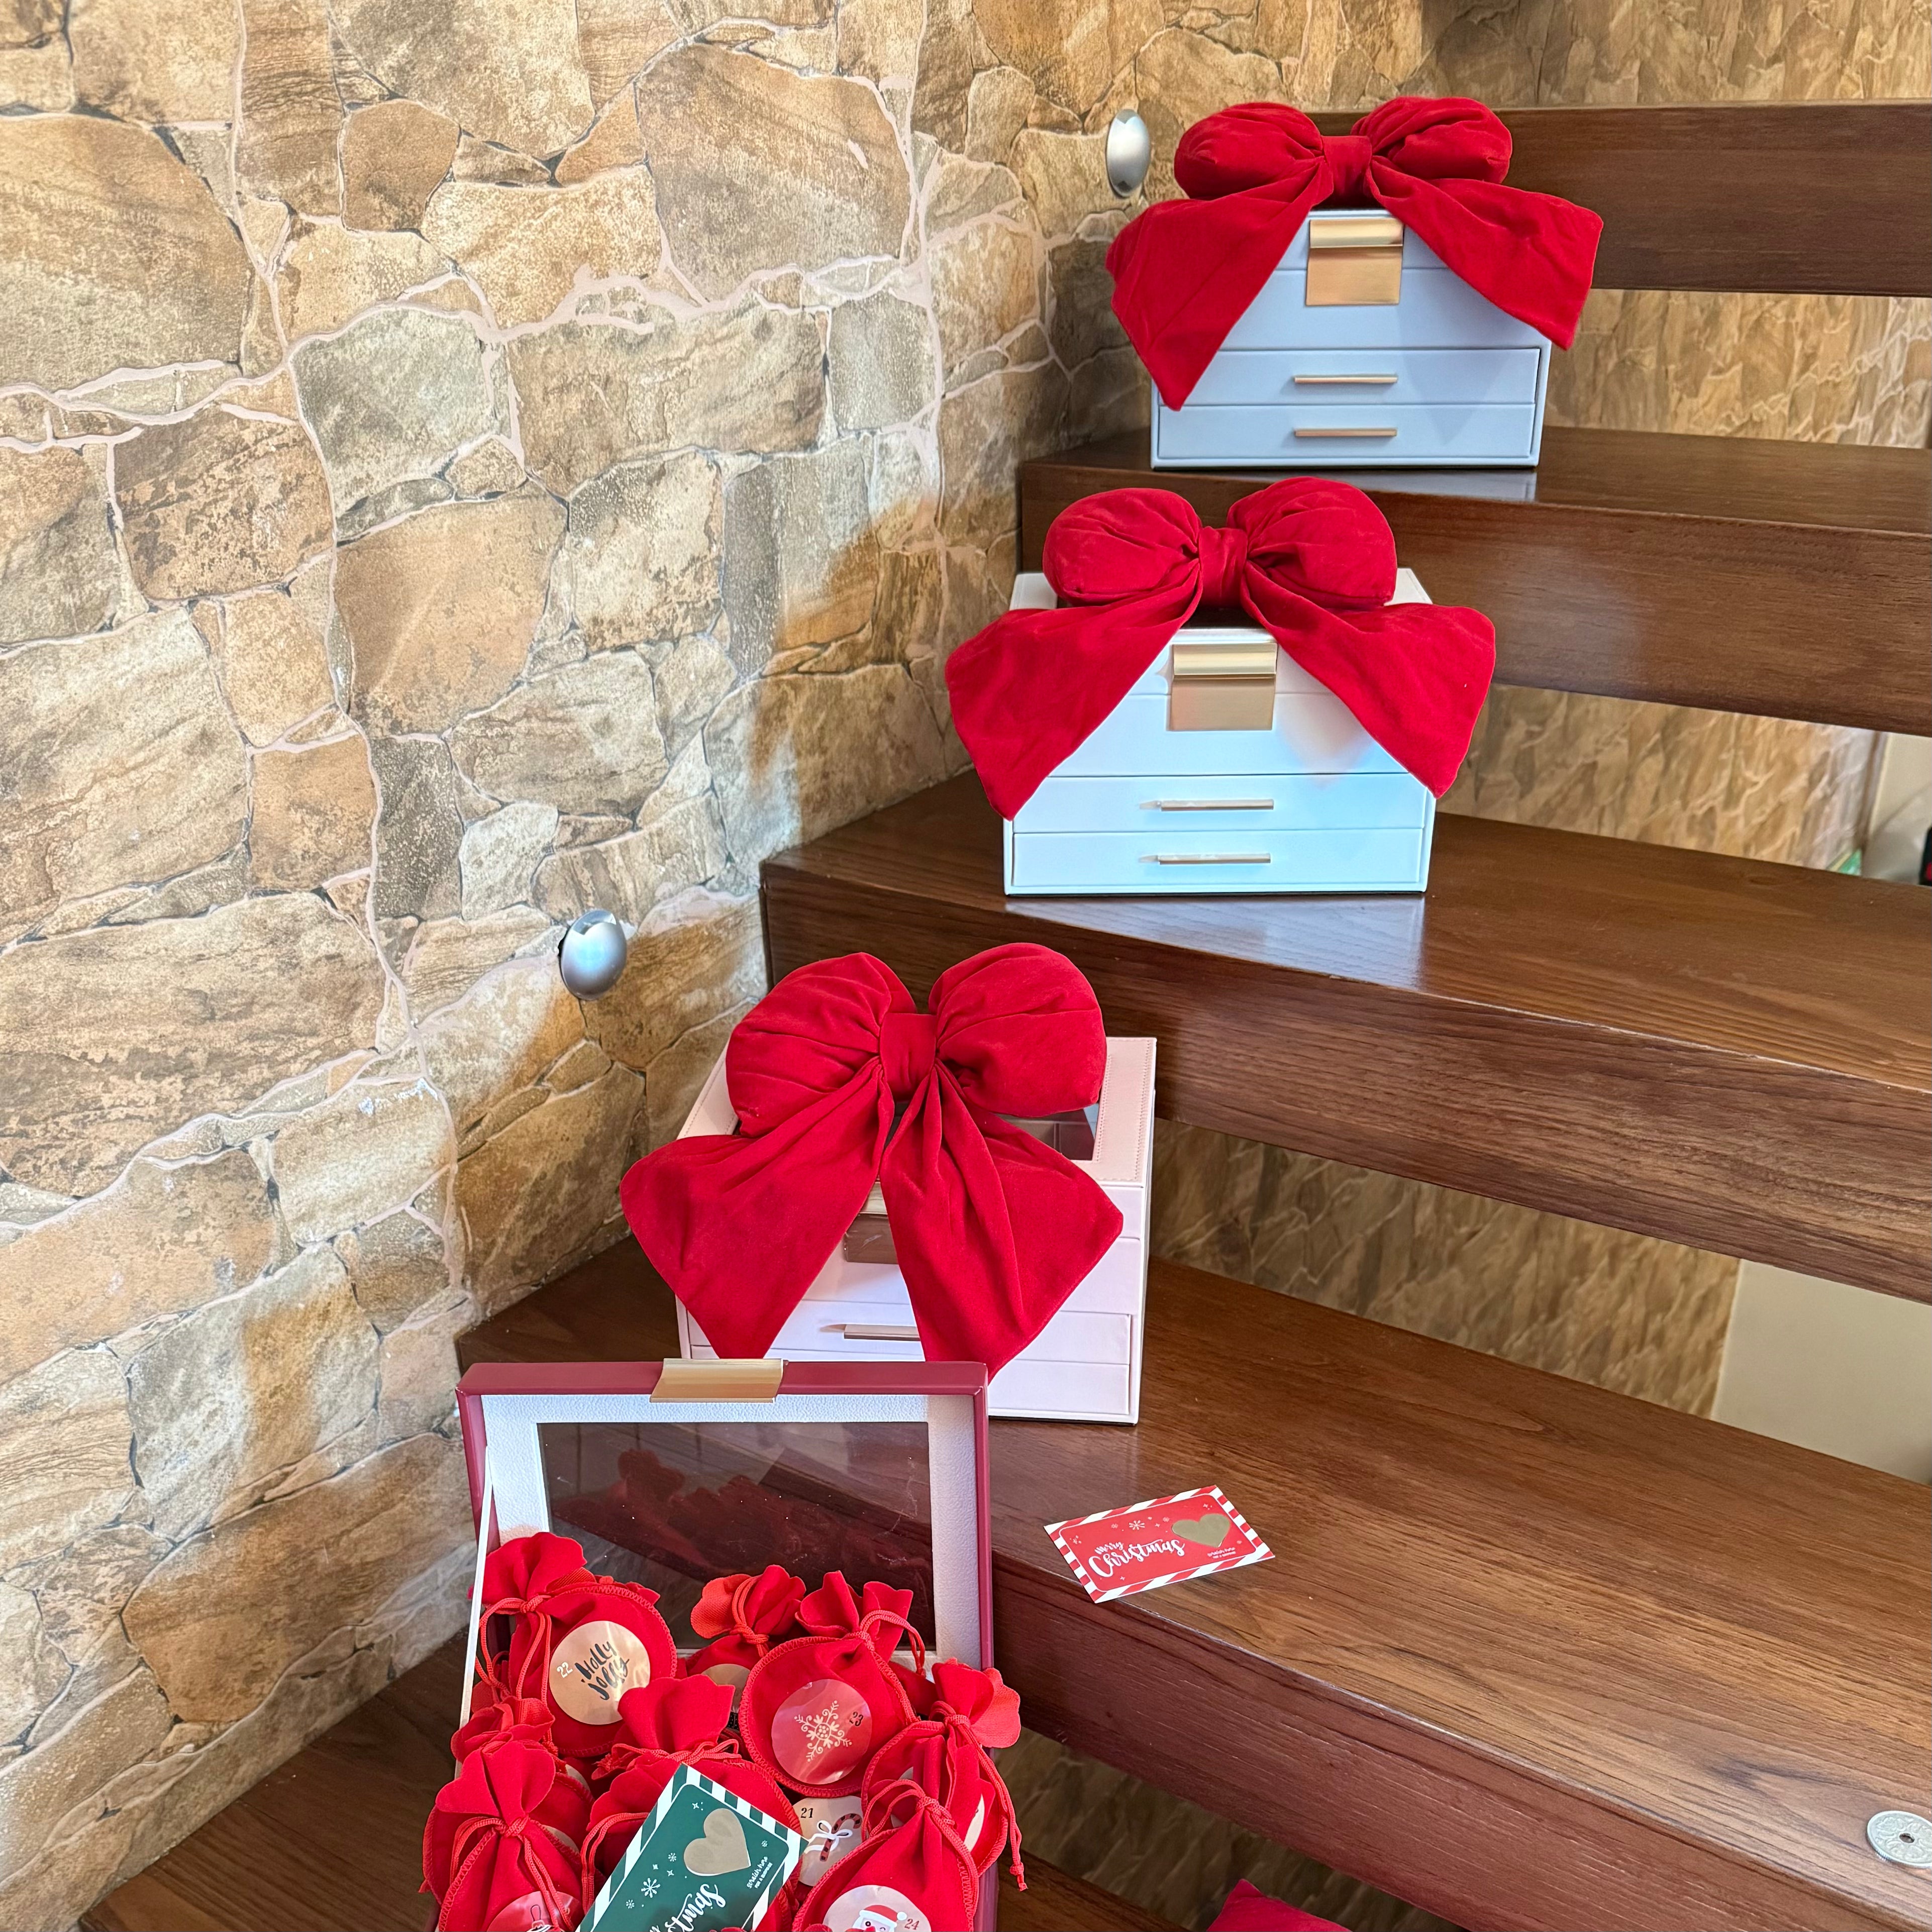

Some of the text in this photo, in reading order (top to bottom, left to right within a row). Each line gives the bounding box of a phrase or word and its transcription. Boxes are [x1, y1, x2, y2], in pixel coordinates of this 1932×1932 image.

[1088, 1539, 1185, 1577] Christmas
[557, 1662, 573, 1678] 22
[800, 1807, 814, 1818] 21
[904, 1918, 920, 1930] 24
